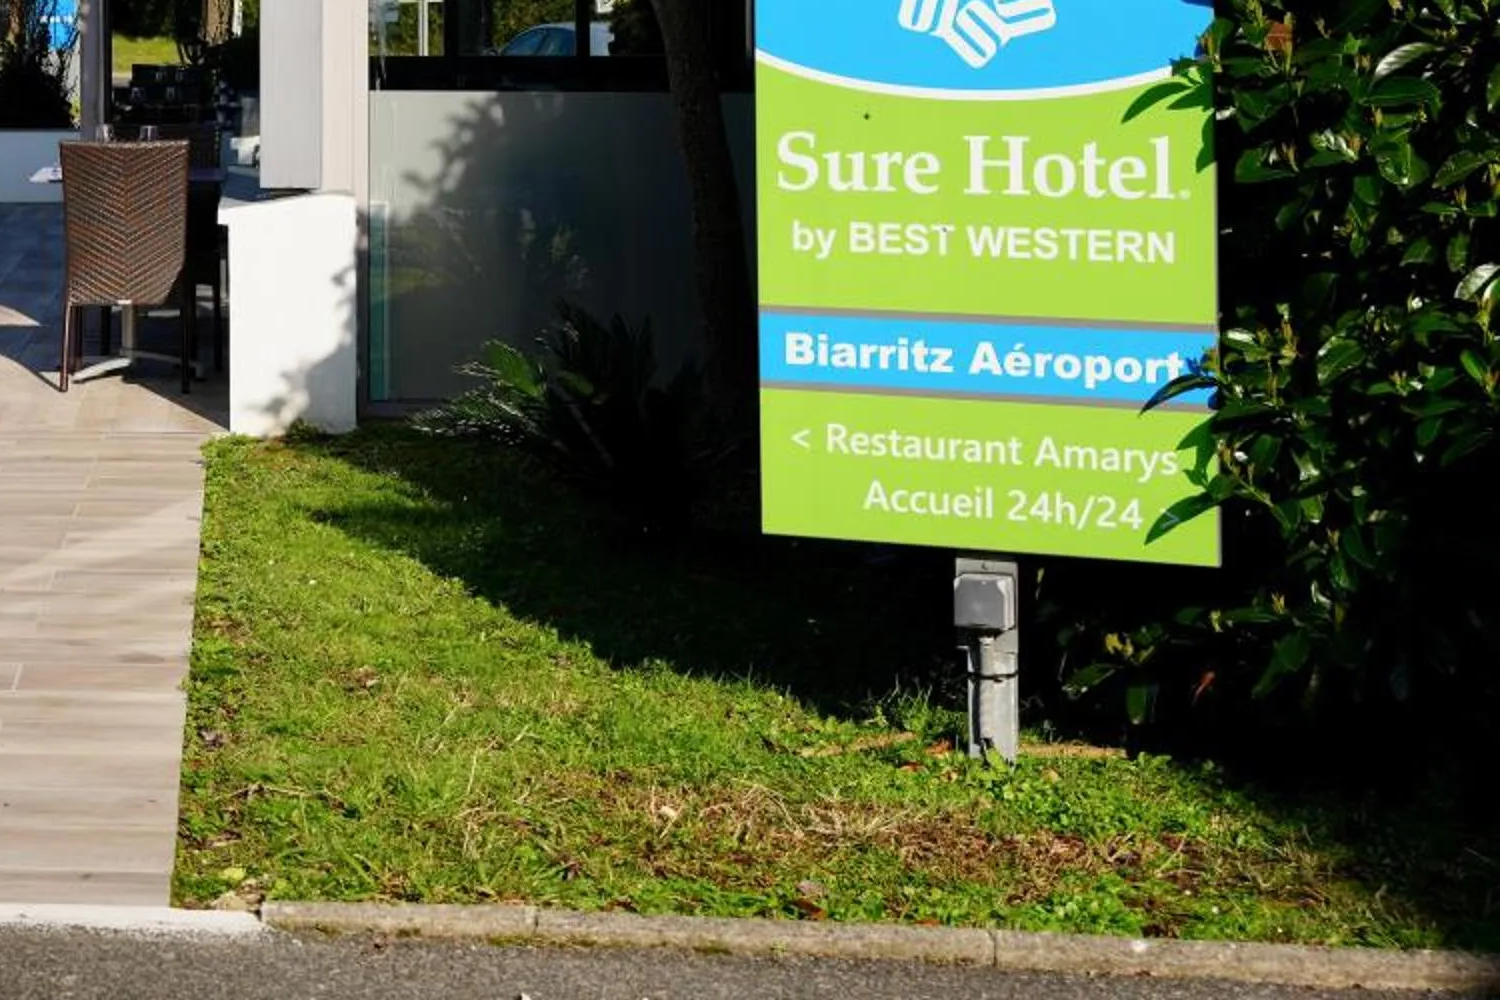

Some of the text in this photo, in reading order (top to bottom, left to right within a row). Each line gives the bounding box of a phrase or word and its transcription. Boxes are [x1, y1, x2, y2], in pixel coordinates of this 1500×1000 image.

[776, 130, 1176, 200] Sure Hotel
[792, 220, 1176, 264] by BEST WESTERN
[785, 332, 1185, 389] Biarritz Aéroport
[826, 423, 1179, 483] Restaurant Amarys
[864, 479, 1144, 531] Accueil 24h/24
